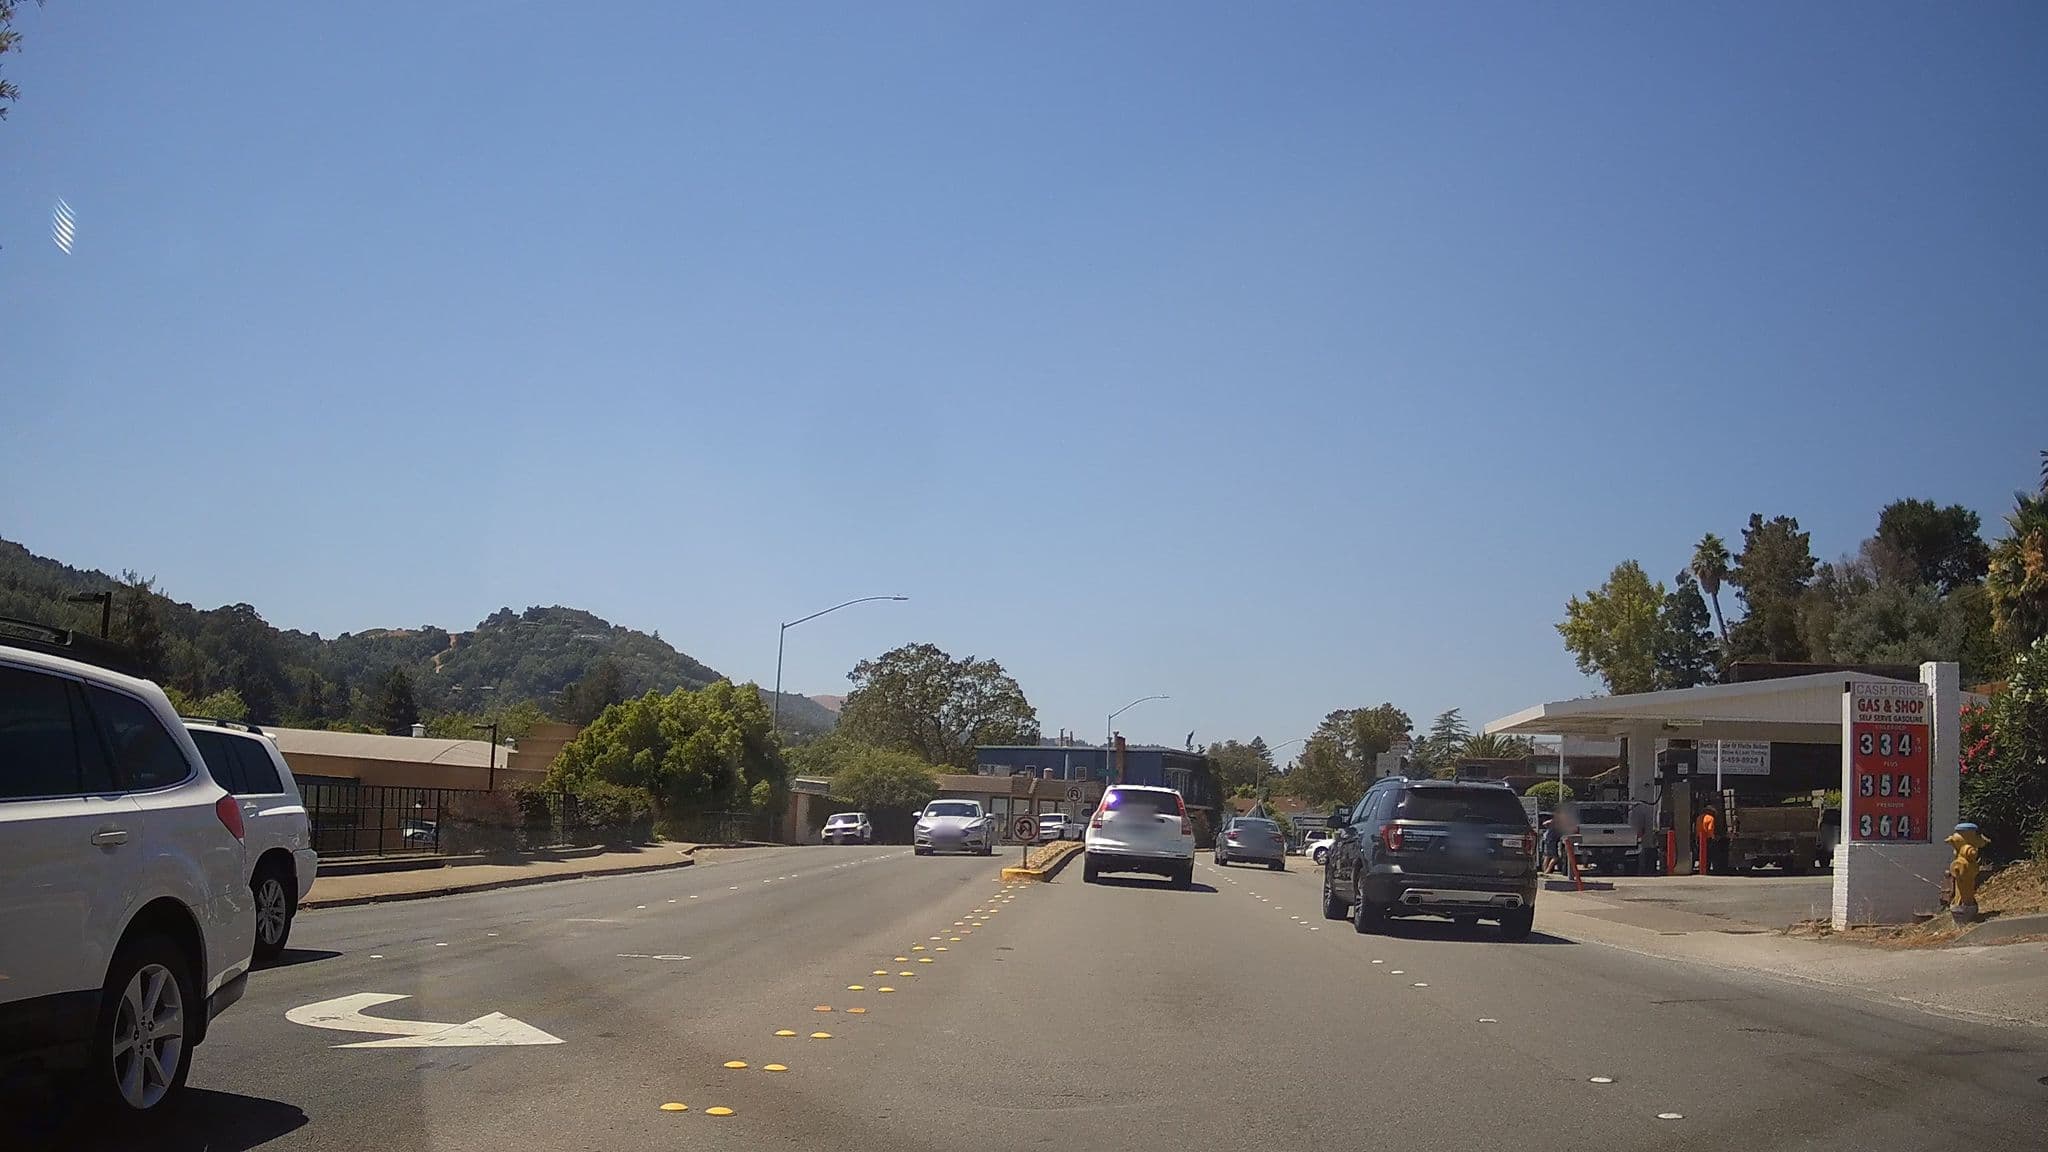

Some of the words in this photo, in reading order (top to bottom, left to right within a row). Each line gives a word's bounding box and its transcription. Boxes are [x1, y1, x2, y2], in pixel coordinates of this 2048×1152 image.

[1856, 684, 1888, 695] CASH
[1891, 685, 1925, 697] PRICE
[1858, 699, 1880, 712] GAS
[1883, 700, 1892, 713] &
[1894, 700, 1924, 713] SHOP
